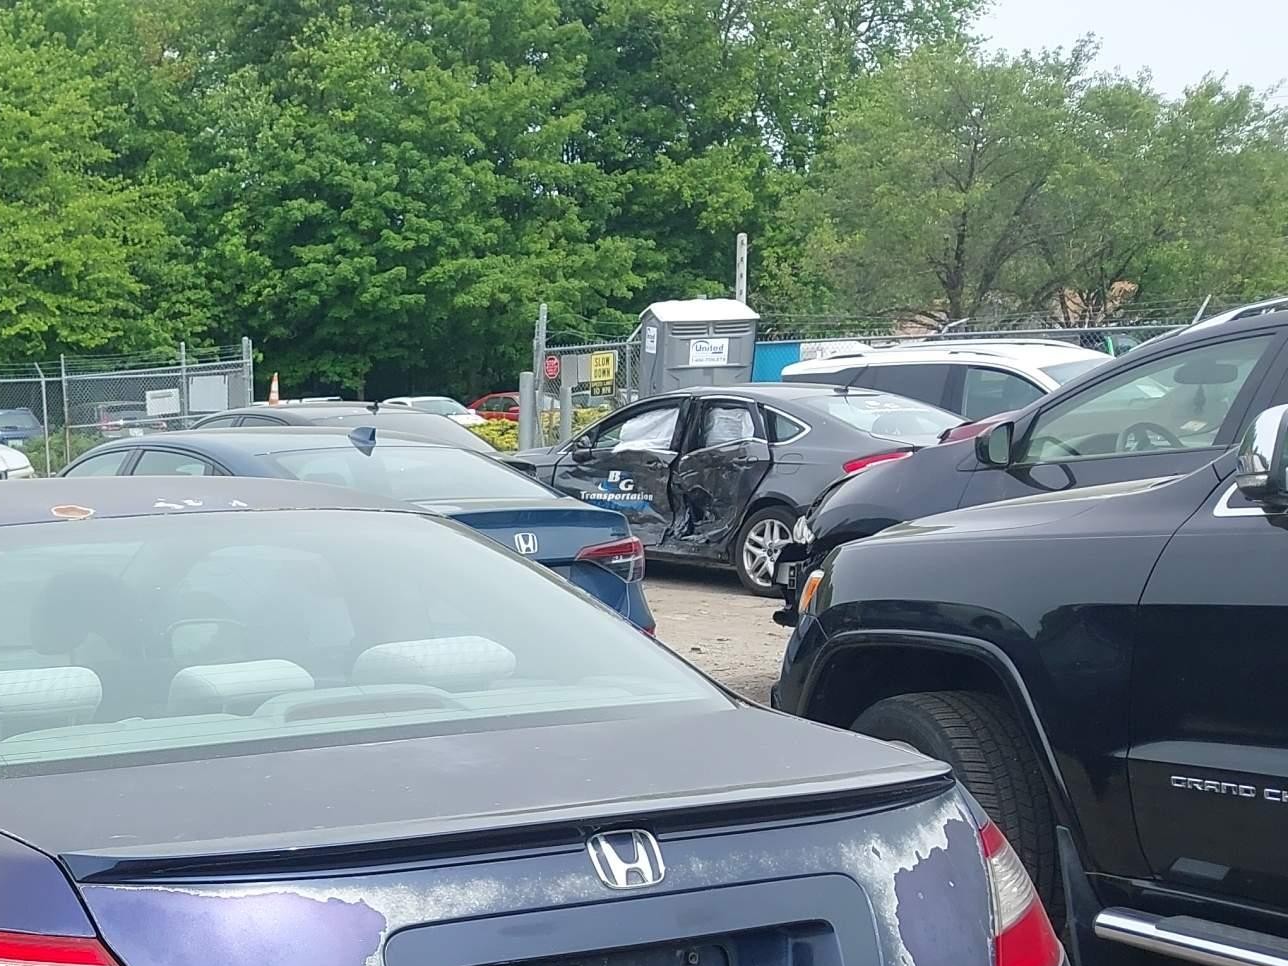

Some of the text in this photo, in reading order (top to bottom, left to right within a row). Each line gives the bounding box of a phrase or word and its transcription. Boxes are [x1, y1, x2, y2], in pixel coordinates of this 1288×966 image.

[695, 343, 724, 352] United
[594, 357, 610, 367] SLOW
[594, 367, 611, 378] DOWN
[580, 490, 654, 501] Transportation
[1170, 776, 1256, 797] GRAND
